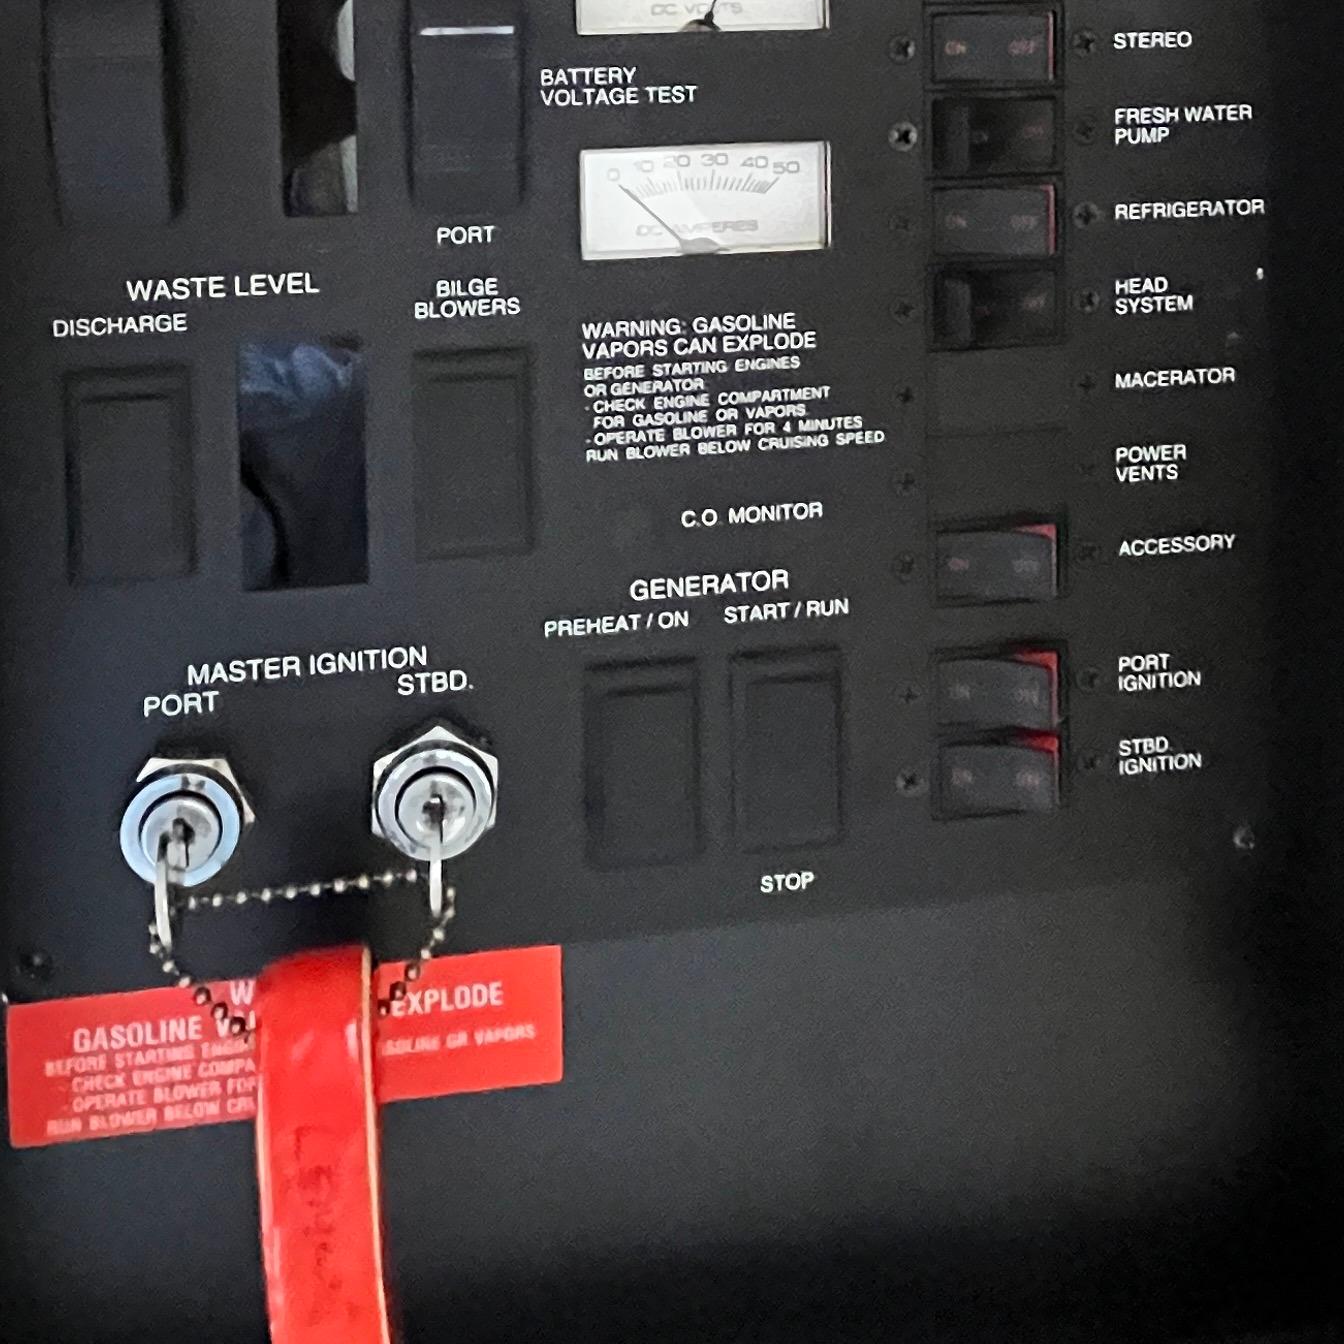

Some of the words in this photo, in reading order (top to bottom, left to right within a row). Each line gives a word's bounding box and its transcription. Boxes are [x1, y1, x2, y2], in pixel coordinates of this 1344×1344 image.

[651, 3, 677, 16] DC
[1114, 31, 1192, 49] STEREO
[541, 67, 636, 86] BATTERY
[541, 87, 639, 106] VOLTAGE
[645, 86, 697, 103] TEST
[1115, 107, 1179, 124] FRESH
[1184, 104, 1252, 122] WATER
[1115, 127, 1169, 144] PUMP
[701, 154, 728, 166] 30
[741, 156, 768, 169] 40
[773, 161, 800, 174] 50
[1115, 199, 1264, 219] REFRIGERATOR
[437, 226, 495, 244] PORT
[126, 276, 226, 301] WASTE
[235, 272, 319, 296] LEVEL
[436, 278, 498, 297] BILGE
[1115, 277, 1168, 294] HEAD
[415, 297, 520, 319] BLOWERS
[1116, 295, 1193, 315] SYSTEM
[53, 313, 187, 337] DISCHARGE
[581, 318, 687, 339] WARNING:
[692, 312, 796, 334] GASOLINE
[582, 339, 668, 359] VAPORS
[674, 337, 716, 356] CAN
[723, 331, 816, 352] EXPLODE
[584, 364, 645, 381] BEFORE
[652, 359, 727, 377] STARTING
[735, 356, 801, 372] ENGINES
[1115, 367, 1235, 388] MACERATOR
[584, 385, 605, 398] OR
[610, 378, 705, 396] GENERATOR
[654, 393, 710, 410] ENGINE
[718, 386, 831, 405] COMPARTMENT
[593, 416, 625, 429] FOR
[632, 410, 708, 427] GASOLINE
[716, 409, 739, 422] OR
[673, 425, 737, 440] BLOWER
[744, 422, 776, 436] FOR
[782, 420, 790, 433] 4
[798, 416, 863, 432] MINUTES
[586, 448, 618, 463] RUN
[626, 443, 690, 460] BLOWER
[698, 439, 750, 455] BELOW
[758, 434, 829, 451] CRUISING
[836, 430, 885, 445] SPEED
[1116, 444, 1186, 463] POWER
[1116, 464, 1178, 482] VENTS
[729, 501, 823, 524] MONITOR
[1119, 534, 1235, 556] ACCESSORY
[630, 569, 788, 601] GENERATOR
[724, 602, 790, 624] START
[794, 602, 801, 618] /
[807, 598, 849, 617] RUN
[545, 614, 641, 637] PREHEAT
[647, 613, 653, 628] /
[658, 611, 688, 629] ON
[188, 656, 301, 685] MASTER
[310, 646, 430, 678] IGNITION
[1119, 653, 1170, 672] PORT
[398, 670, 473, 695] STBD.
[1118, 671, 1201, 691] IGNITION
[144, 691, 219, 717] PORT
[1119, 754, 1201, 775] IGNITION
[761, 872, 814, 893] STOP
[74, 1016, 202, 1053] GASOLINE
[45, 1054, 106, 1077] BEFORE
[115, 1045, 195, 1067] STARTING
[133, 1065, 192, 1086] ENGINE
[153, 1080, 222, 1104] BLOWER
[89, 1107, 156, 1131] BLOWER
[164, 1099, 220, 1122] BELOW
